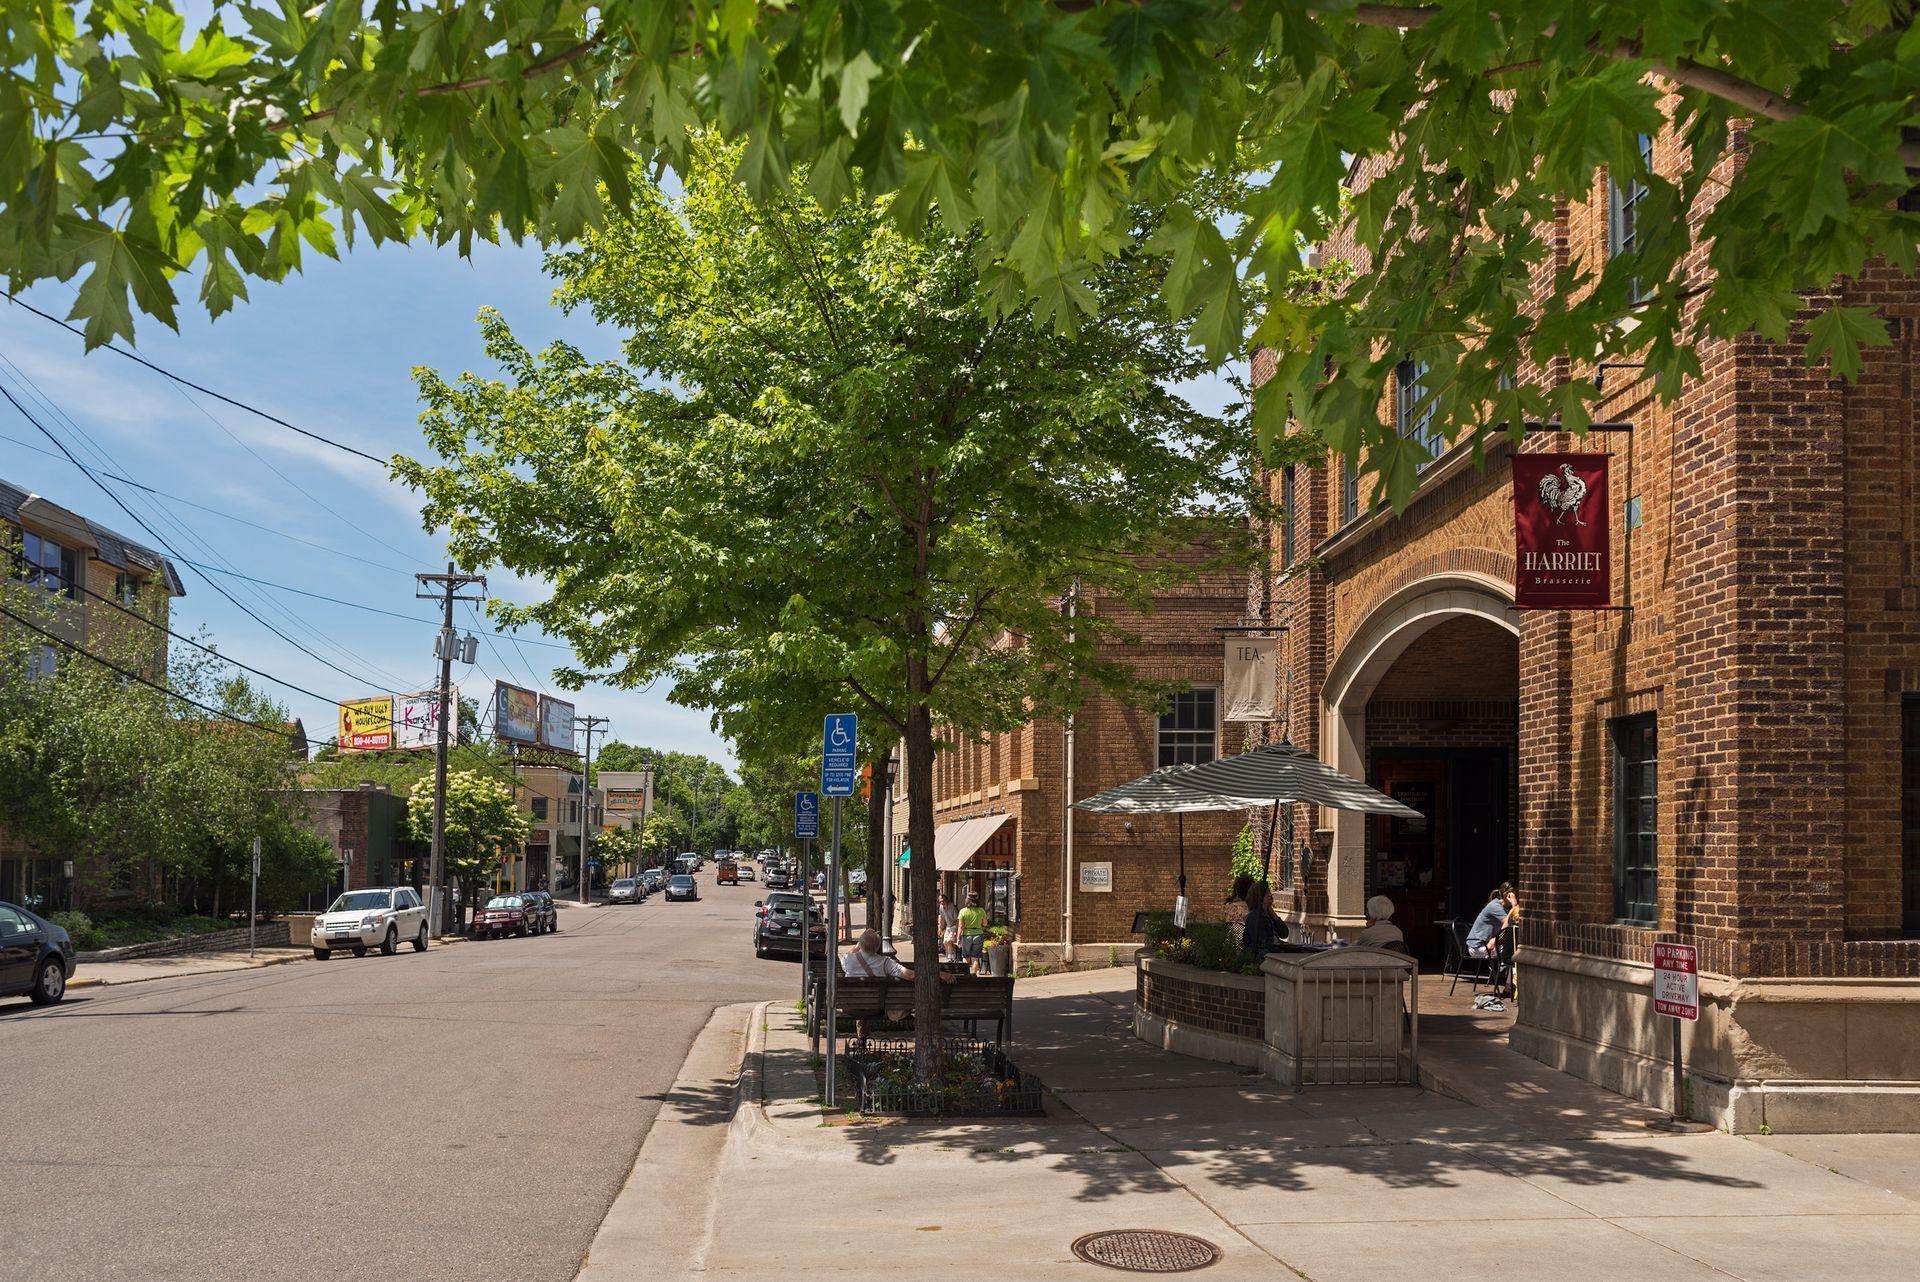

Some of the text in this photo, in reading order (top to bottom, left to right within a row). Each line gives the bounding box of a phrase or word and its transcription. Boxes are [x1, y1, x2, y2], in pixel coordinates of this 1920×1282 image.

[1525, 552, 1602, 571] HARRIET
[364, 705, 373, 714] BUY
[374, 703, 388, 714] UGLY
[404, 705, 424, 731] Kars
[1656, 947, 1694, 961] NO PARKING
[1662, 959, 1688, 970] ANY TIME
[1663, 972, 1688, 983] 24 HOUR
[1666, 982, 1686, 993] ACTIVE
[1661, 991, 1690, 1003] DRIVEWAY
[1657, 1002, 1695, 1017] TOW AWAY ZONE
